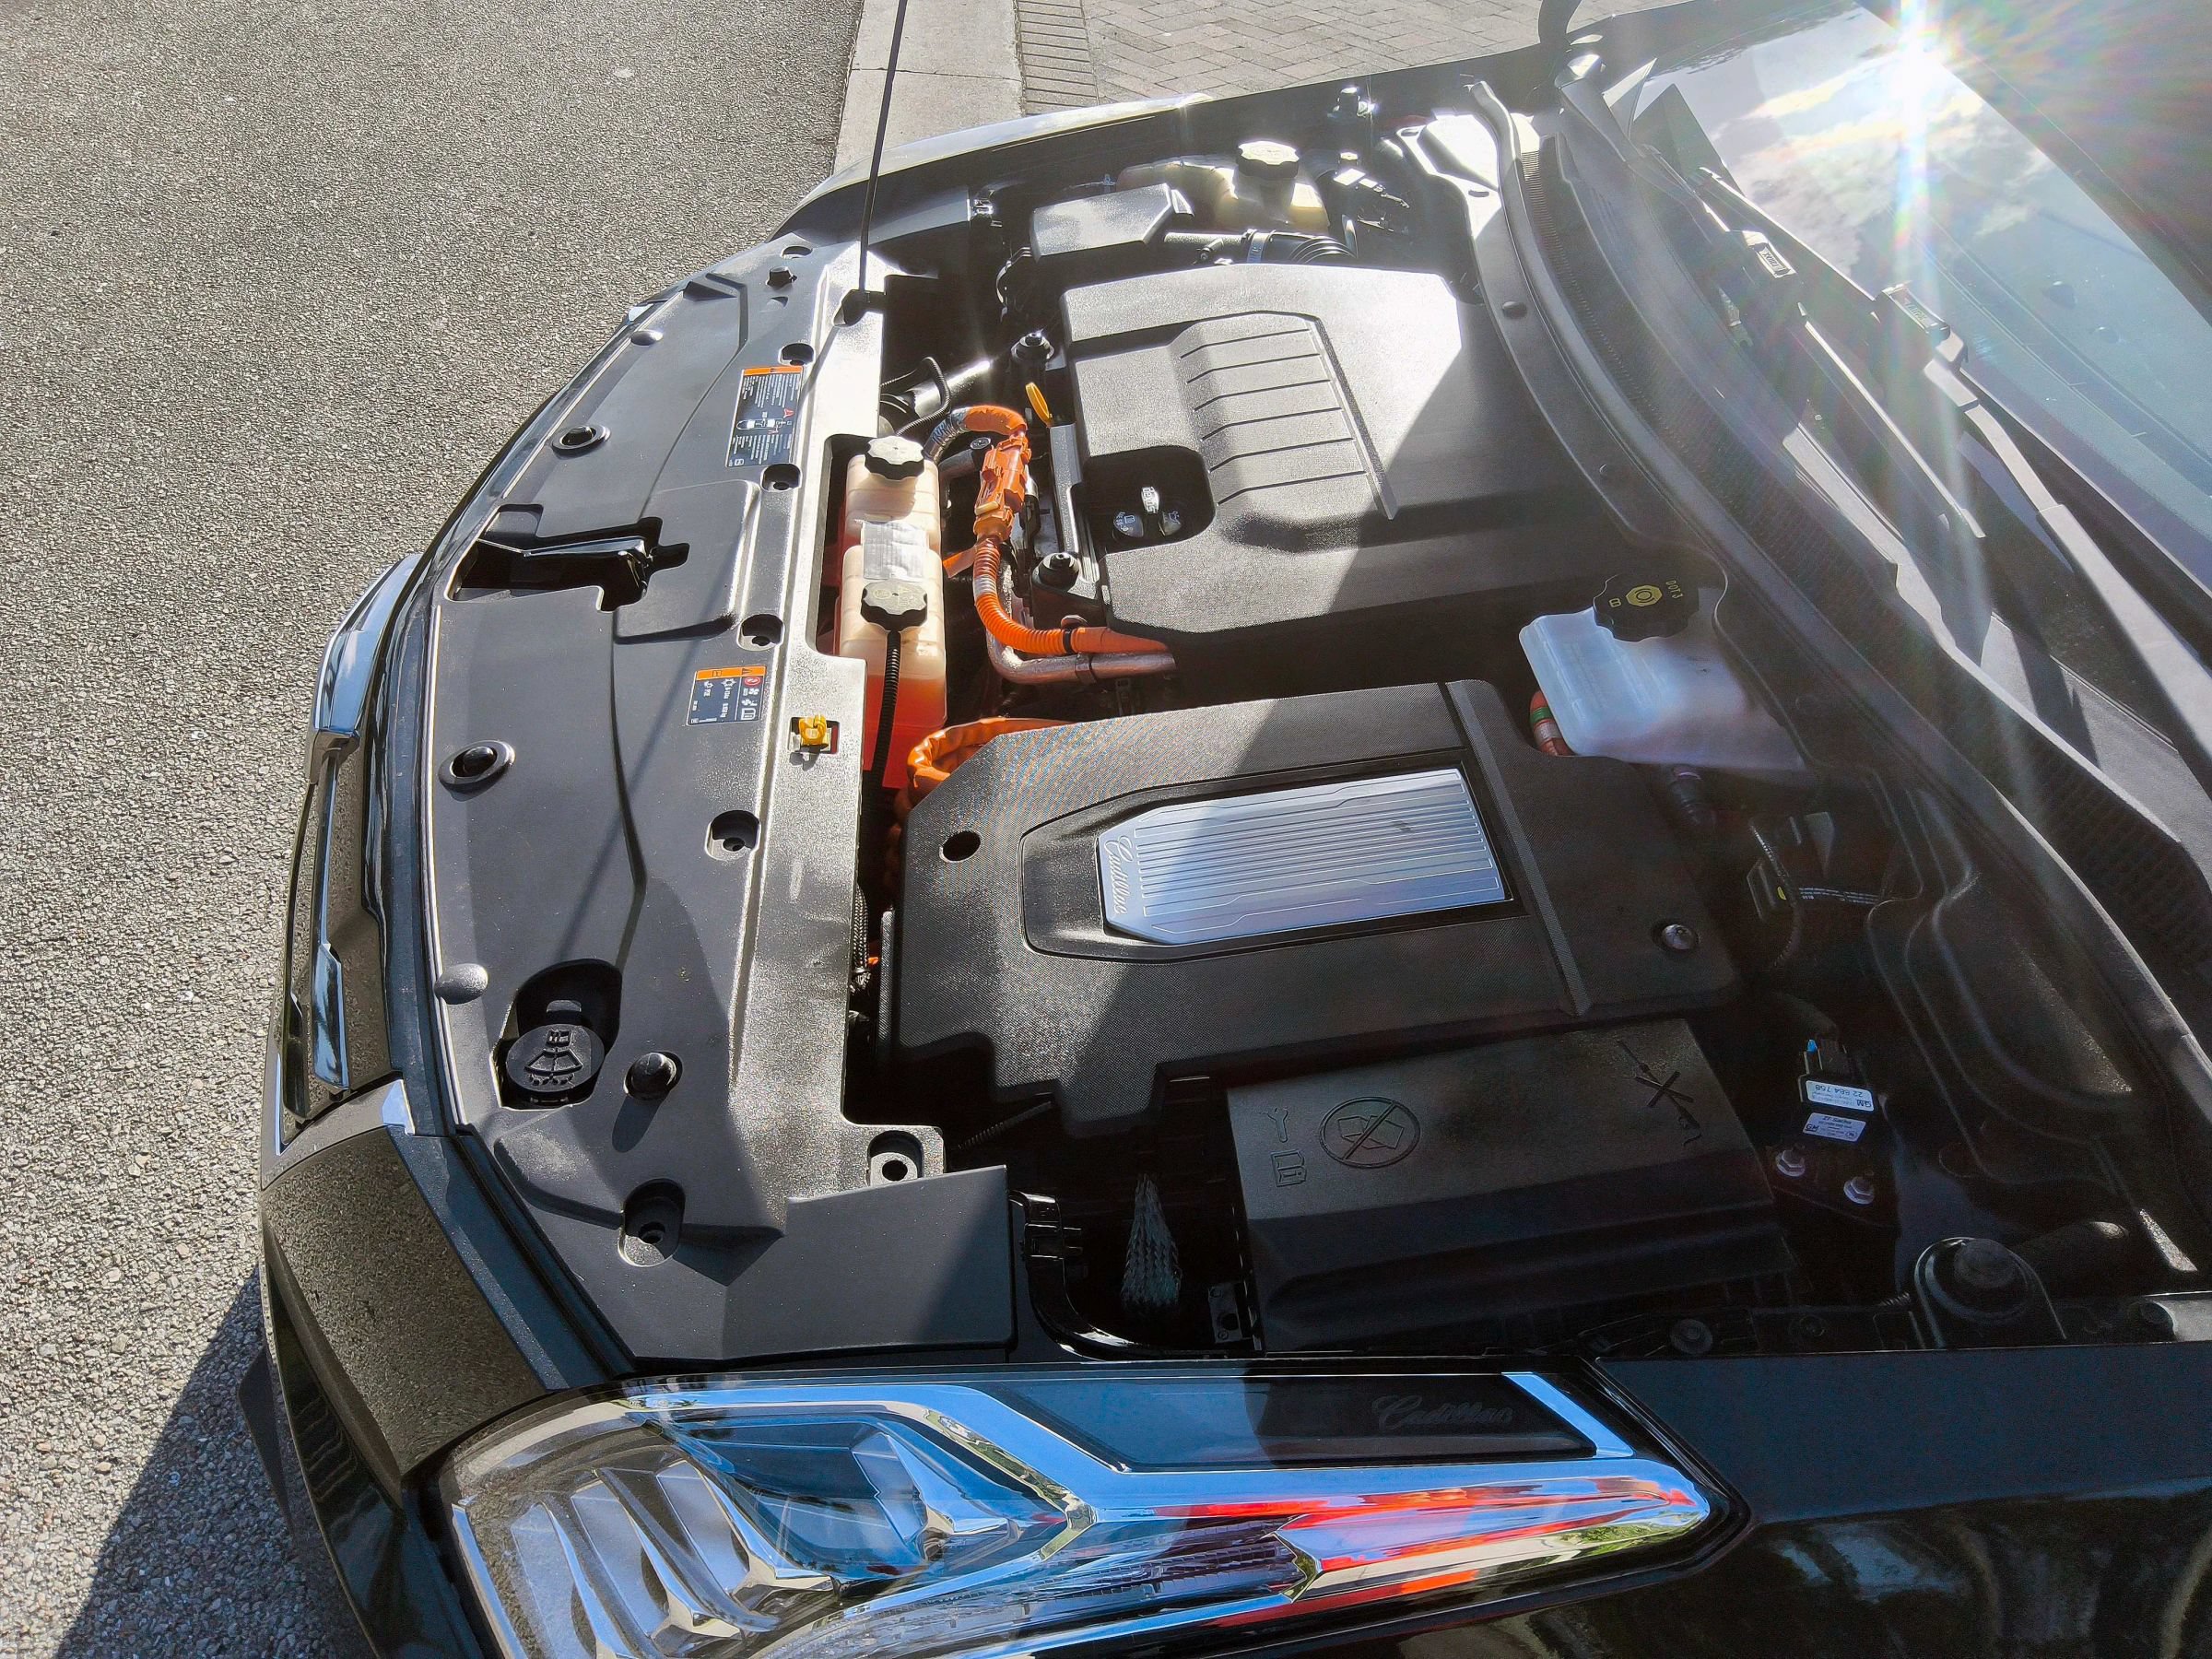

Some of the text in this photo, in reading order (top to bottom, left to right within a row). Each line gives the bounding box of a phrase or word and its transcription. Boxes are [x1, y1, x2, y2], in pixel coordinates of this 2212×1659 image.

[1665, 580, 1681, 594] DOT
[1104, 835, 1133, 914] Cadillac
[1856, 1099, 1872, 1108] GM
[1805, 1124, 1820, 1132] GM
[1371, 1394, 1514, 1430] Cadillac
